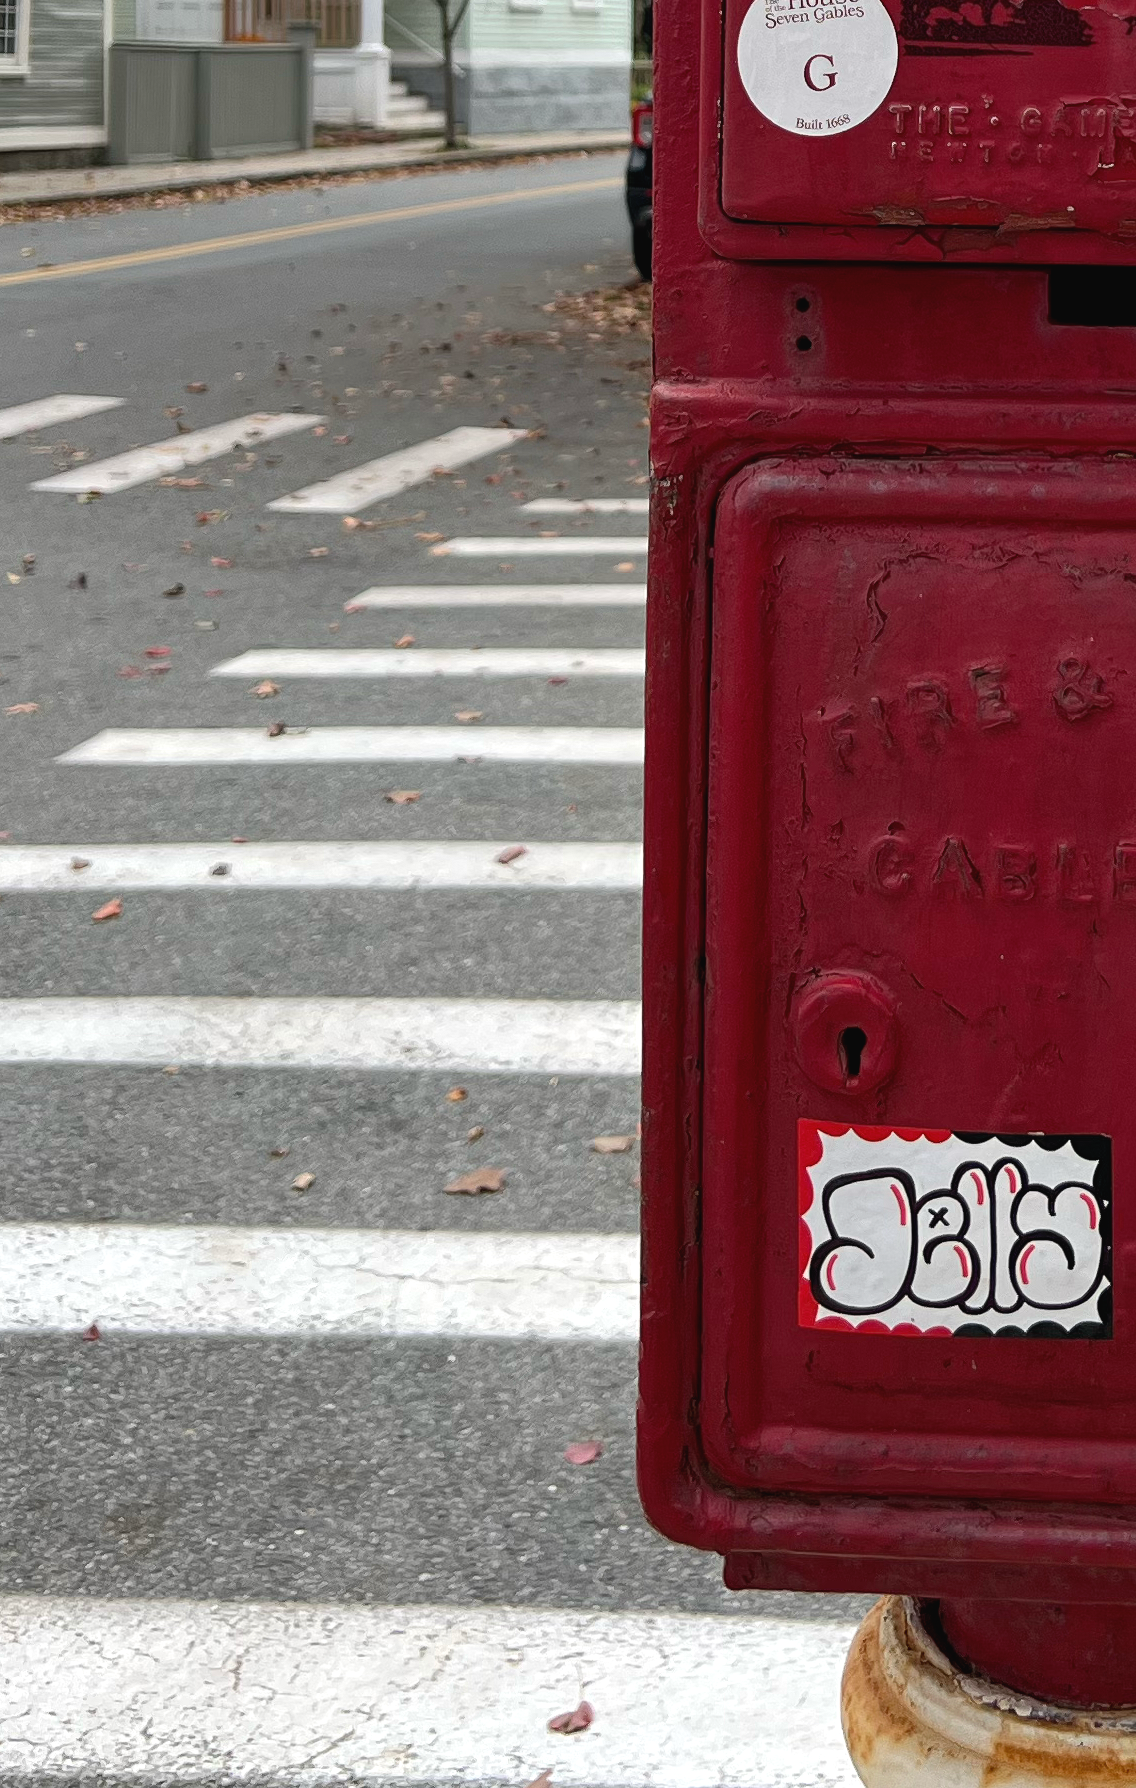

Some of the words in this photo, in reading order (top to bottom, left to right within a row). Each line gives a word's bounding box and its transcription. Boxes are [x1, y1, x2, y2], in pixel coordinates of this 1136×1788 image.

[765, 12, 809, 29] Seven
[814, 5, 864, 23] Gables
[804, 54, 838, 92] G
[796, 117, 823, 130] Built
[826, 114, 850, 129] 1668
[889, 104, 969, 135] THE
[822, 664, 1015, 774] FIRE
[1053, 657, 1111, 721] &
